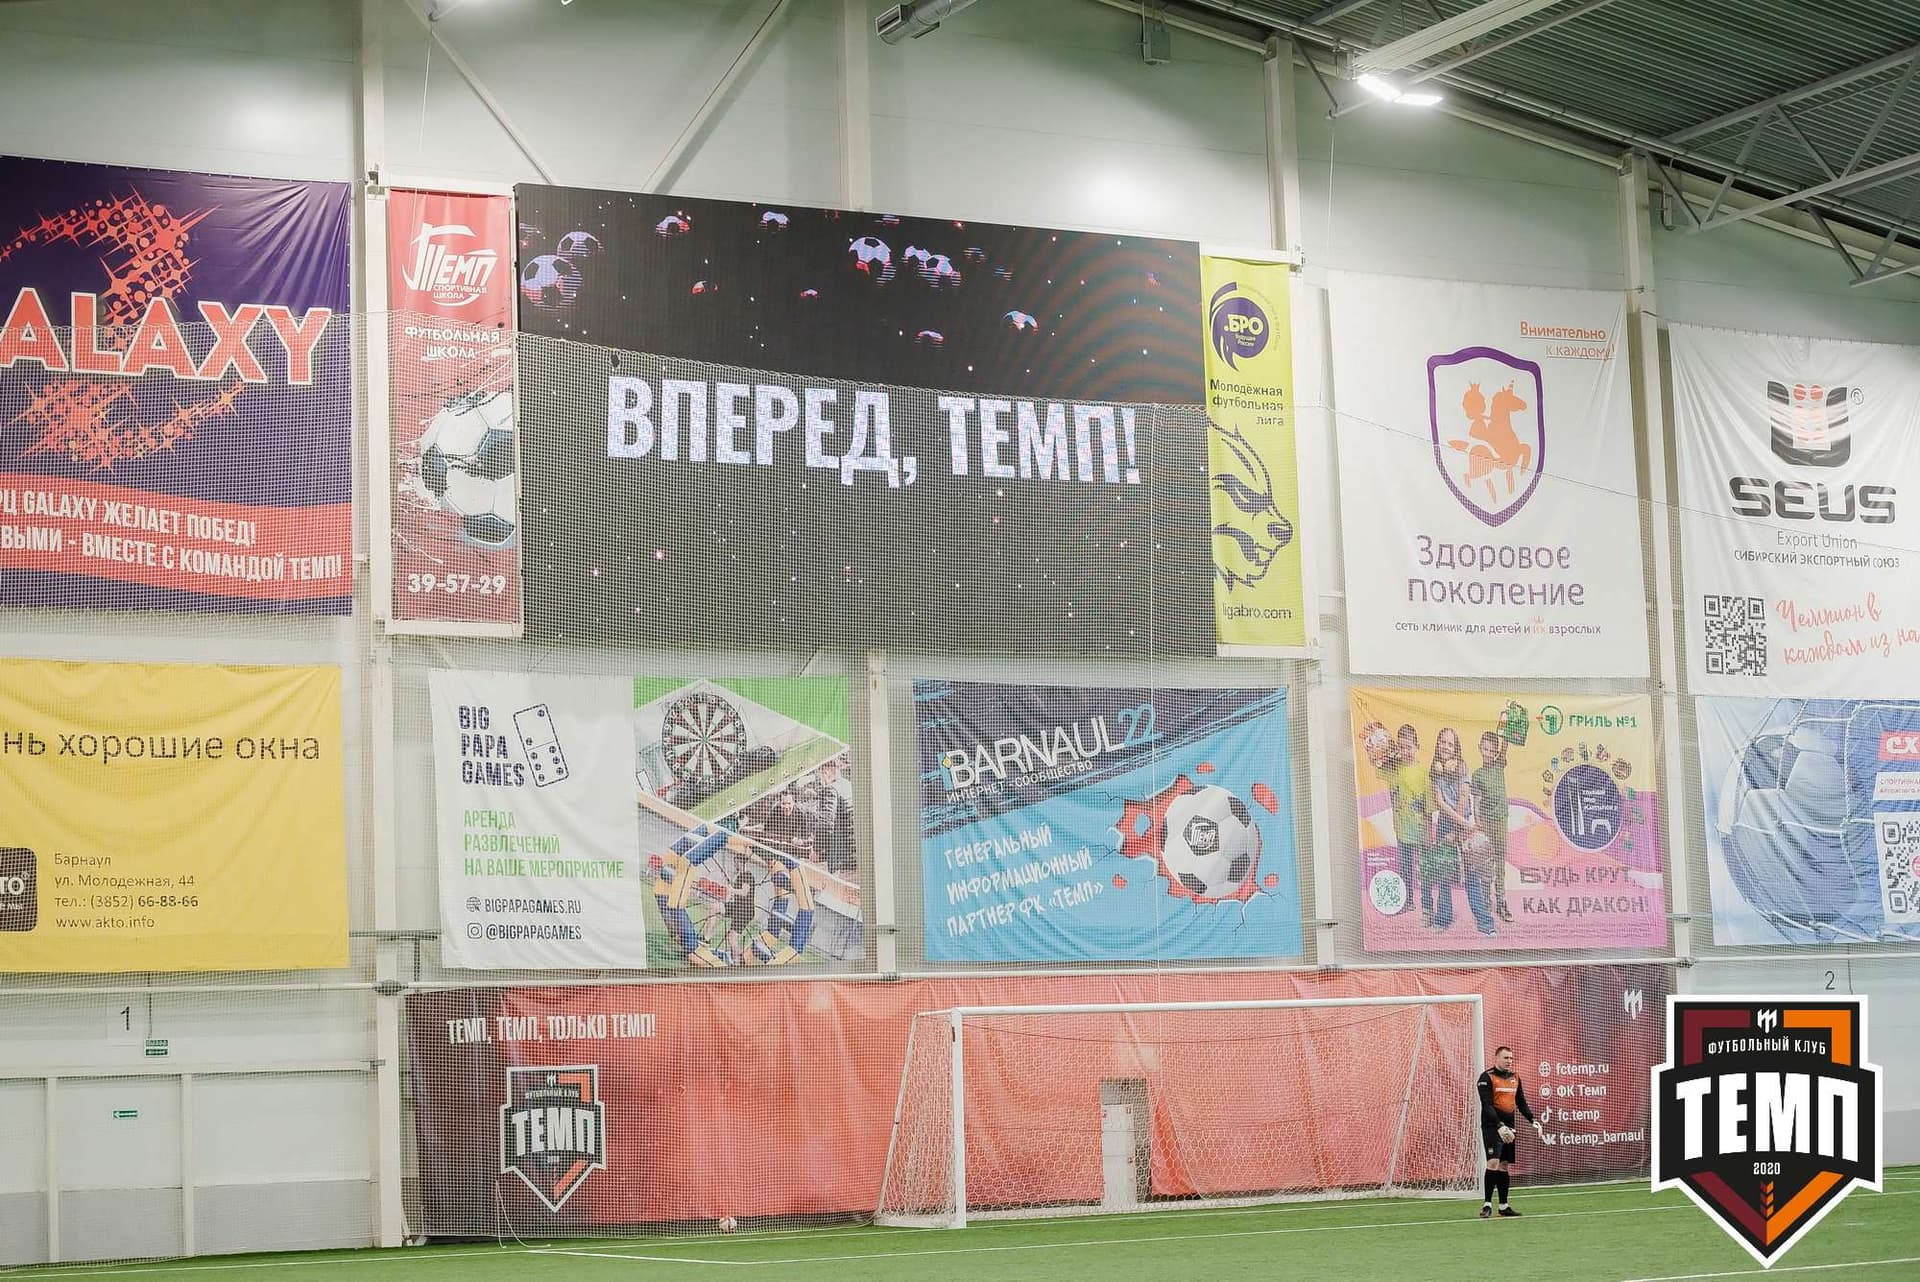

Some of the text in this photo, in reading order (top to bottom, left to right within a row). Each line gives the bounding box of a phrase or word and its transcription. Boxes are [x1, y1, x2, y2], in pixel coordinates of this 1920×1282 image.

[433, 284, 487, 294] СПОРТИВНАЯ
[433, 291, 465, 300] ШКОЛА
[0, 287, 332, 385] ALAXY
[404, 326, 500, 344] ФУТБОЛЬНАЯ
[1520, 321, 1607, 340] Внимательно
[426, 345, 476, 359] ШКОЛА
[1546, 345, 1553, 355] к
[1210, 378, 1283, 397] Молодёжная
[1212, 396, 1284, 412] футбольная
[1256, 416, 1284, 427] лига
[607, 376, 1141, 488] ВПЕРЕД, ТЕМП!
[1729, 476, 1896, 524] SEUS
[0, 489, 257, 546] Ц GALAXY ЖЕЛАЕТ ПОБЕД!
[1777, 530, 1858, 550] Export Union
[1, 525, 62, 553] ВЫМИ
[82, 532, 156, 568] ВМЕСТЕ
[161, 543, 175, 569] С
[179, 543, 284, 581] КОМАНДОЙ
[289, 554, 342, 580] ТЕМП!
[1416, 534, 1571, 571] Здоровое
[1734, 550, 1900, 568] СИБИРСКИЙ ЭКСПОРТНЫЙ СОЮЗ
[408, 574, 506, 595] 39-57-29
[1408, 578, 1585, 606] поколение
[1223, 602, 1292, 619] ligabro.com
[1776, 599, 1865, 632] Чемпион
[1395, 621, 1419, 631] сеть
[1422, 622, 1463, 633] клиник
[1465, 624, 1486, 634] для
[1488, 623, 1522, 635] детей
[1549, 626, 1601, 637] взрослых
[1897, 627, 1920, 646] на
[458, 705, 490, 730] BIG
[1569, 715, 1638, 728] ГРИЛЬ №1
[3, 732, 321, 764] нь хорошие окна
[461, 733, 509, 759] PAPA
[462, 760, 525, 787] GAMES
[947, 781, 1006, 803] ИНТЕРНЕТ
[1015, 760, 1093, 789] СООБЩЕСТВО
[464, 810, 516, 830] АРЕНДА
[464, 833, 560, 854] РАЗВЛЕЧЕНИЙ
[944, 824, 1053, 870] ГЕНЕРАЛЬНЫЙ
[54, 853, 111, 868] Барнаул
[465, 859, 624, 878] НА ВАШЕ МЕРОПРИЯТИЕ
[55, 875, 195, 889] ул. Молодежная, 44
[946, 847, 1092, 904] ИНФОРМАЦИОННЫЙ
[1520, 867, 1579, 887] БУДЬ
[55, 896, 199, 909] тел.: (3852) 66-88-66
[485, 899, 582, 914] BIGPAPAGAMES.RU
[947, 881, 1104, 938] ПАРТНЕР ФК «ТЕМП»
[1523, 896, 1649, 917] КАК ДРАКОН!
[56, 916, 155, 929] www.akto.info
[485, 924, 582, 940] @BIGPAPAGAMES
[1825, 970, 1836, 990] 2
[120, 1006, 130, 1031] 1
[447, 1014, 656, 1044] ТЕМП, ТЕМП, ТОЛЬКО ТЕМП!
[1556, 1063, 1610, 1077] fctemp.ru
[1557, 1085, 1607, 1097] ФК Темп
[1558, 1109, 1600, 1122] fc.temp
[512, 1107, 595, 1156] ТЕМП
[1560, 1128, 1644, 1146] fctemp_barnaul
